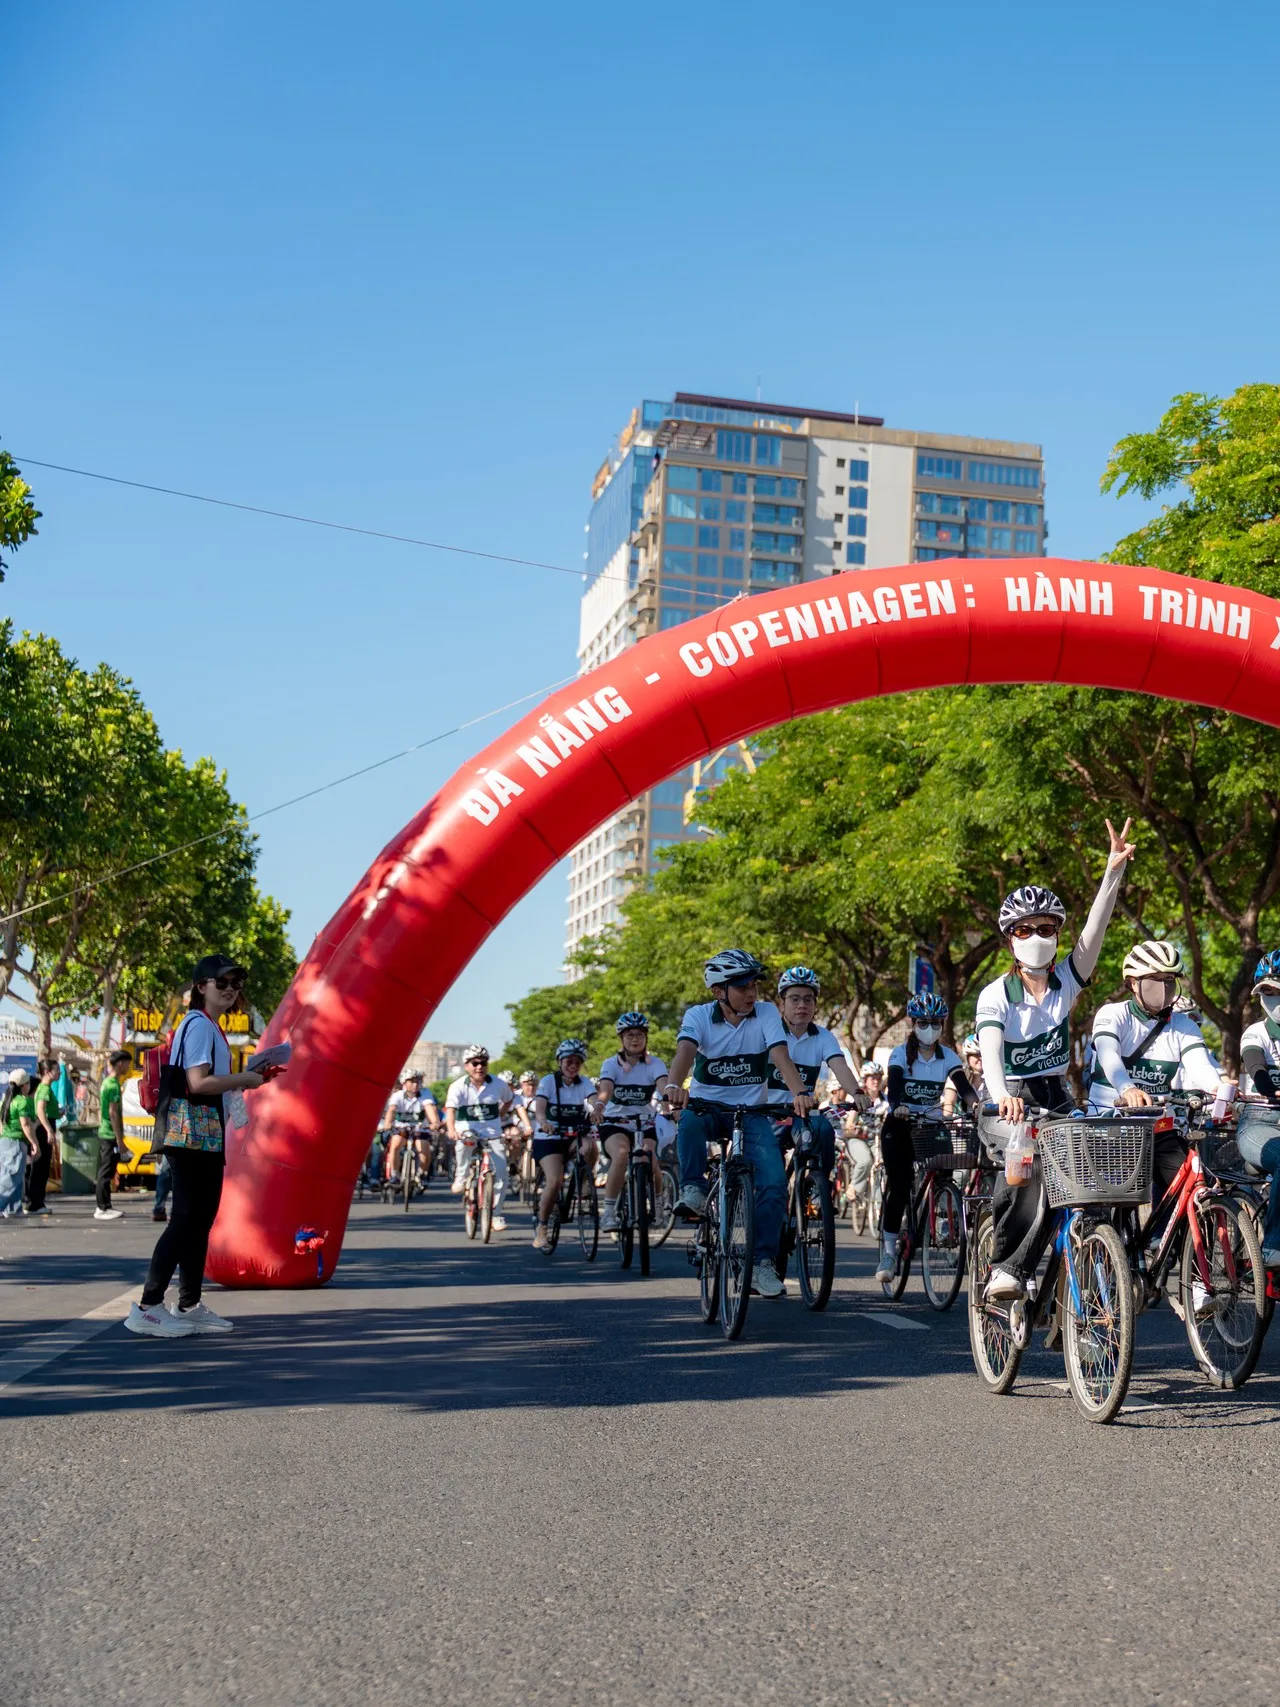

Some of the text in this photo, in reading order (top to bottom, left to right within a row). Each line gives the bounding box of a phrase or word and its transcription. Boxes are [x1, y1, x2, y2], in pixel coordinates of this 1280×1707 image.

[457, 767, 525, 827] ĐÀ
[644, 672, 661, 685] -
[679, 579, 976, 678] COPENHAGEN:
[1004, 572, 1113, 616] HÀNH
[1138, 585, 1251, 640] TRÌNH
[1011, 1035, 1062, 1067] Carlsberg
[707, 1060, 752, 1079] Carlsberg
[1126, 1065, 1168, 1085] rlsberg
[728, 1075, 763, 1086] Vietnam
